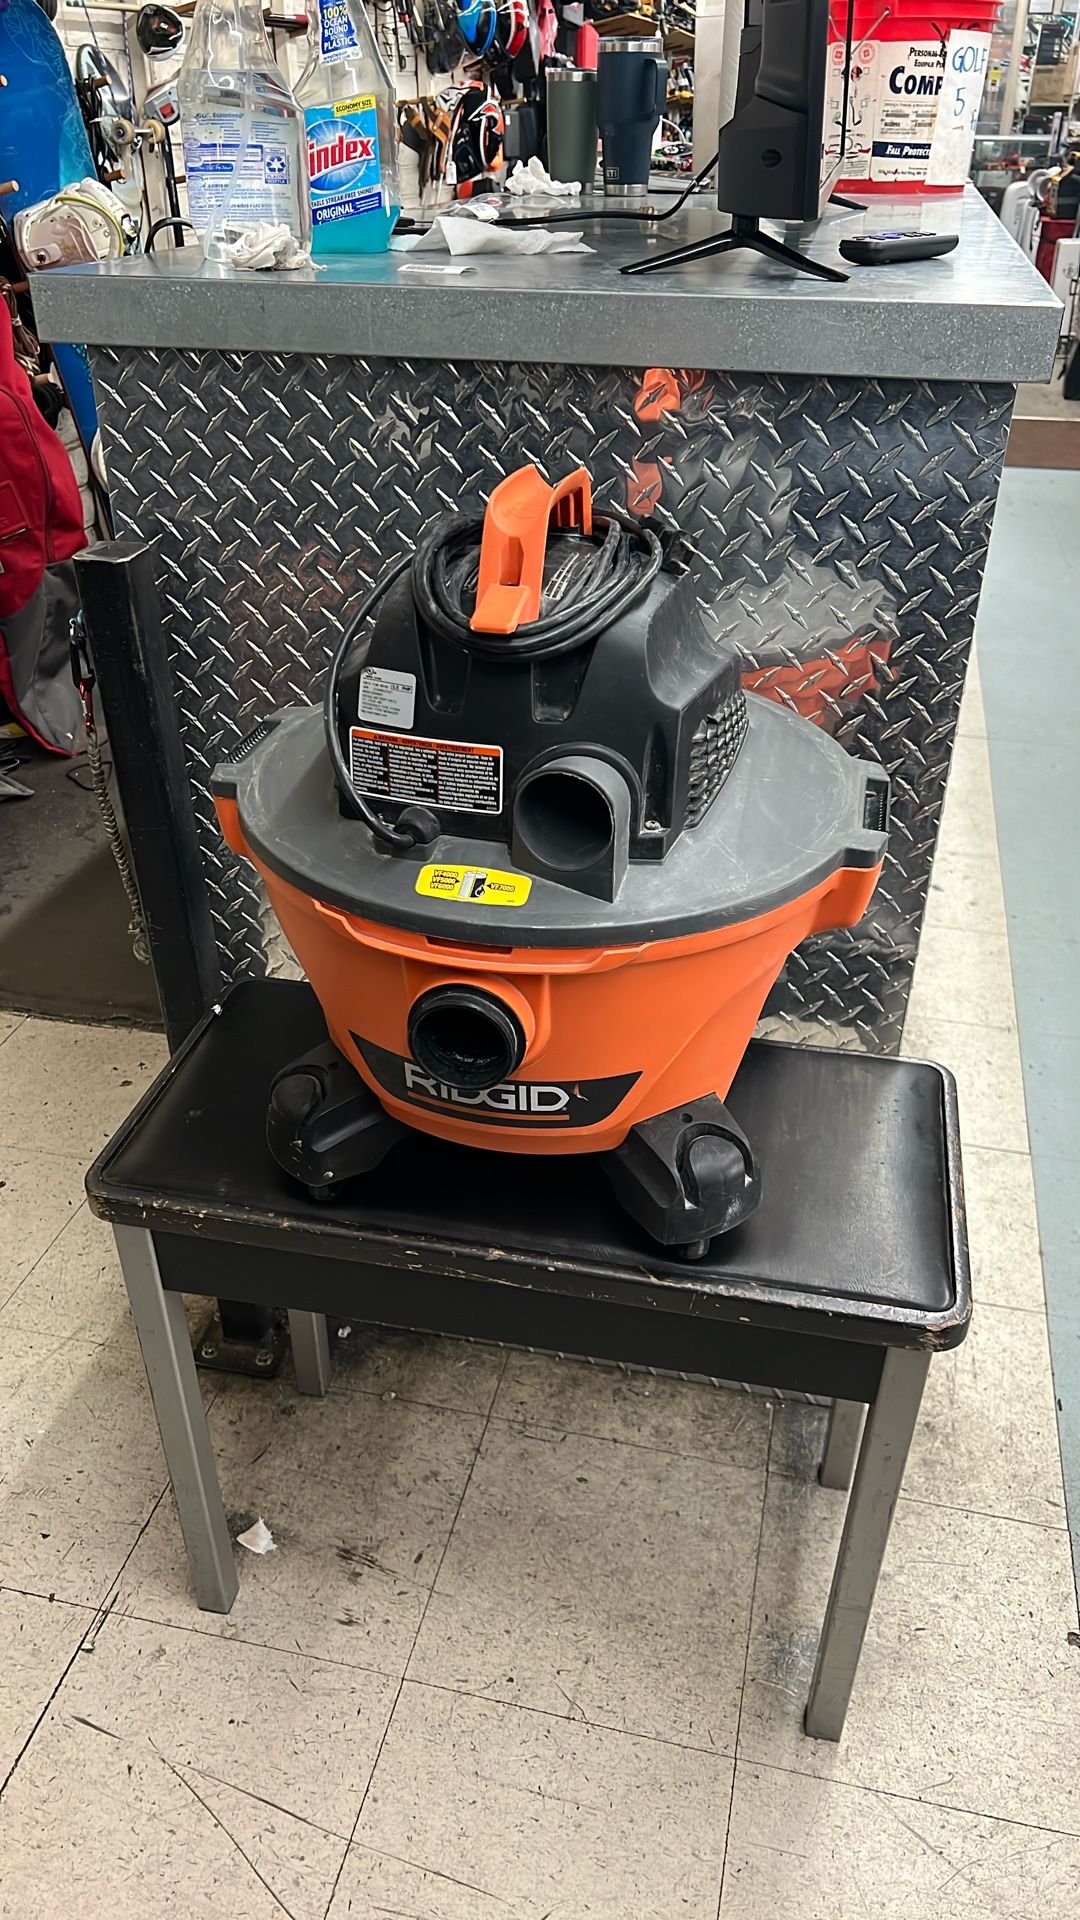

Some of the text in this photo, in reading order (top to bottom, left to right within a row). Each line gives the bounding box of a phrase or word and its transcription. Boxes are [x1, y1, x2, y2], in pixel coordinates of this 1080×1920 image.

[324, 5, 346, 19] 100%
[324, 15, 348, 28] OCEAN
[324, 24, 348, 37] BOUND
[324, 36, 354, 50] PLASTIC
[952, 46, 988, 74] GOLF
[889, 66, 943, 95] COMP
[336, 102, 360, 112] ECONOMY
[362, 99, 372, 107] SIZE
[954, 87, 966, 116] 5
[307, 135, 372, 178] index
[885, 145, 900, 155] FALL
[325, 192, 356, 204] STREAK-FREE
[316, 203, 354, 220] ORIGINAL
[404, 1062, 570, 1112] RIDGID
